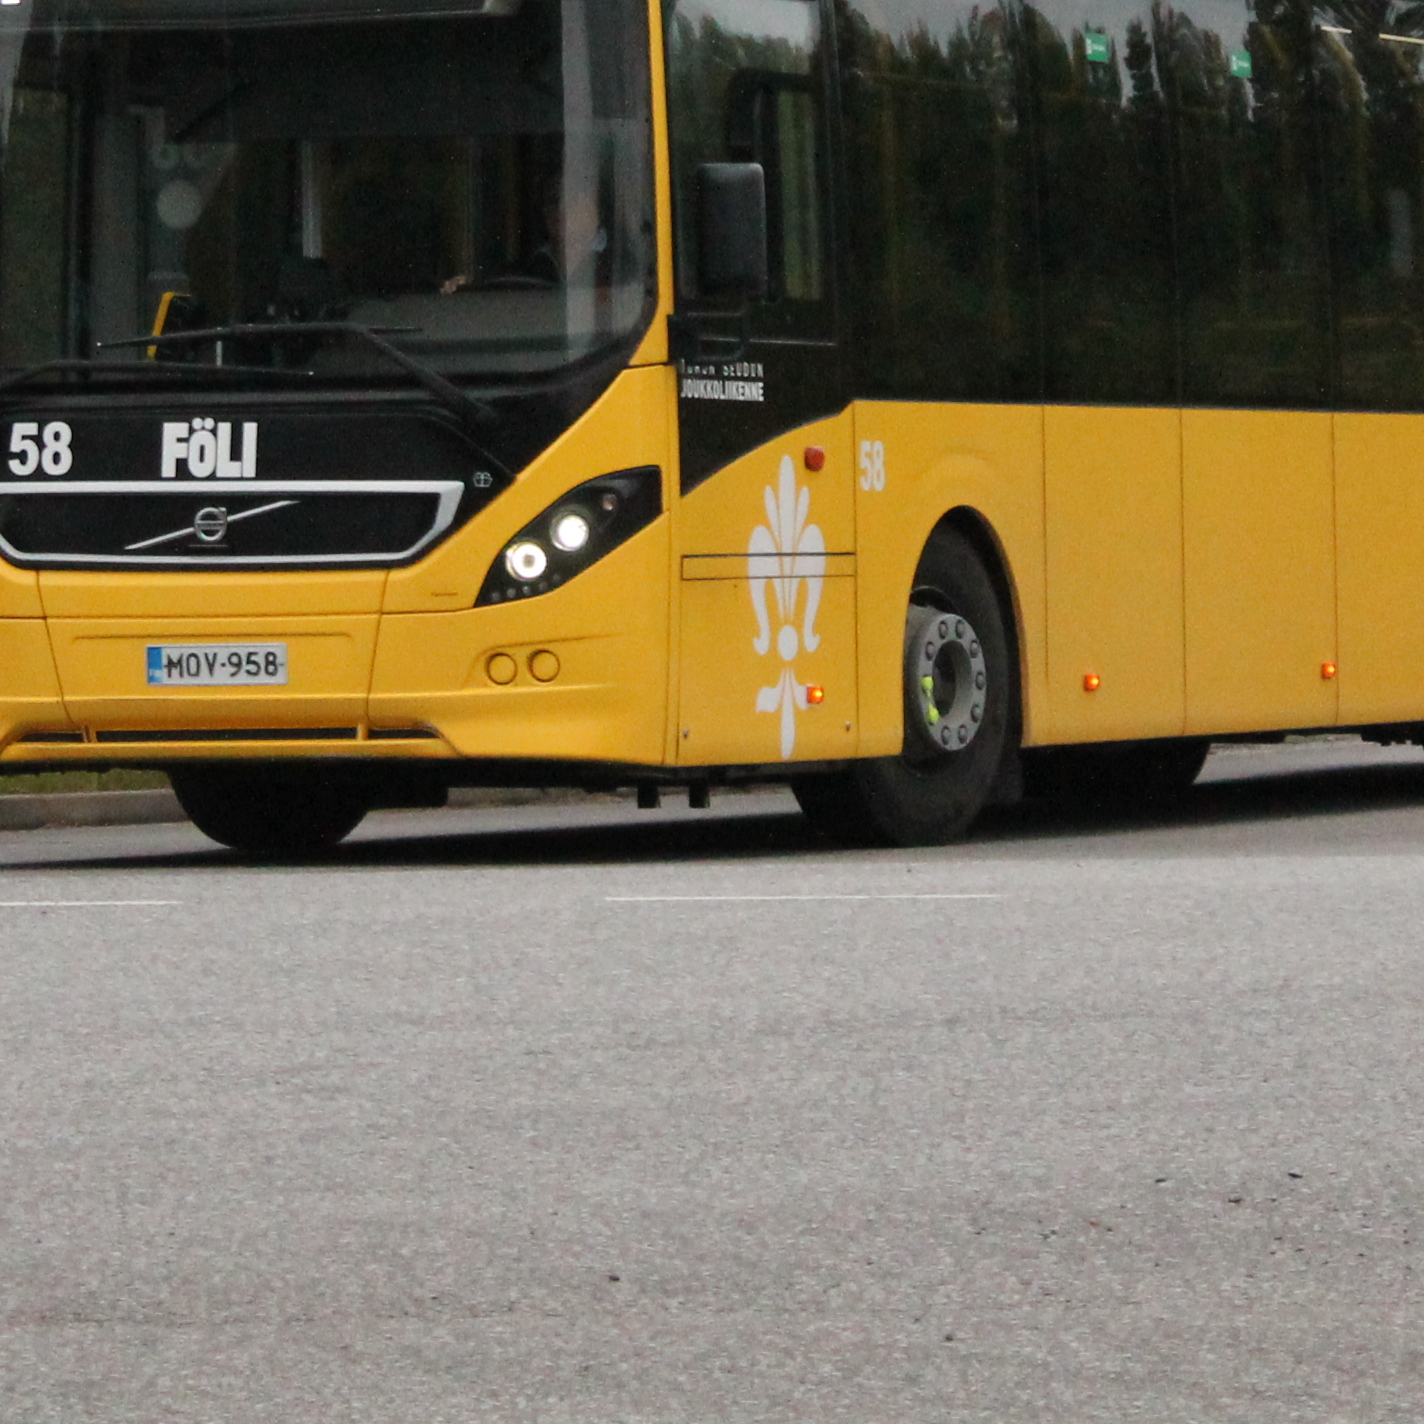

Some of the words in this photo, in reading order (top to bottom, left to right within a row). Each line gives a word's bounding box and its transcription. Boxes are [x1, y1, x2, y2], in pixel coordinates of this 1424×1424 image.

[680, 379, 765, 402] JOUKKOLIIKENNE
[8, 421, 73, 476] 58
[161, 417, 258, 478] FÖLI
[859, 440, 886, 492] 58
[167, 651, 279, 678] MOV-958
